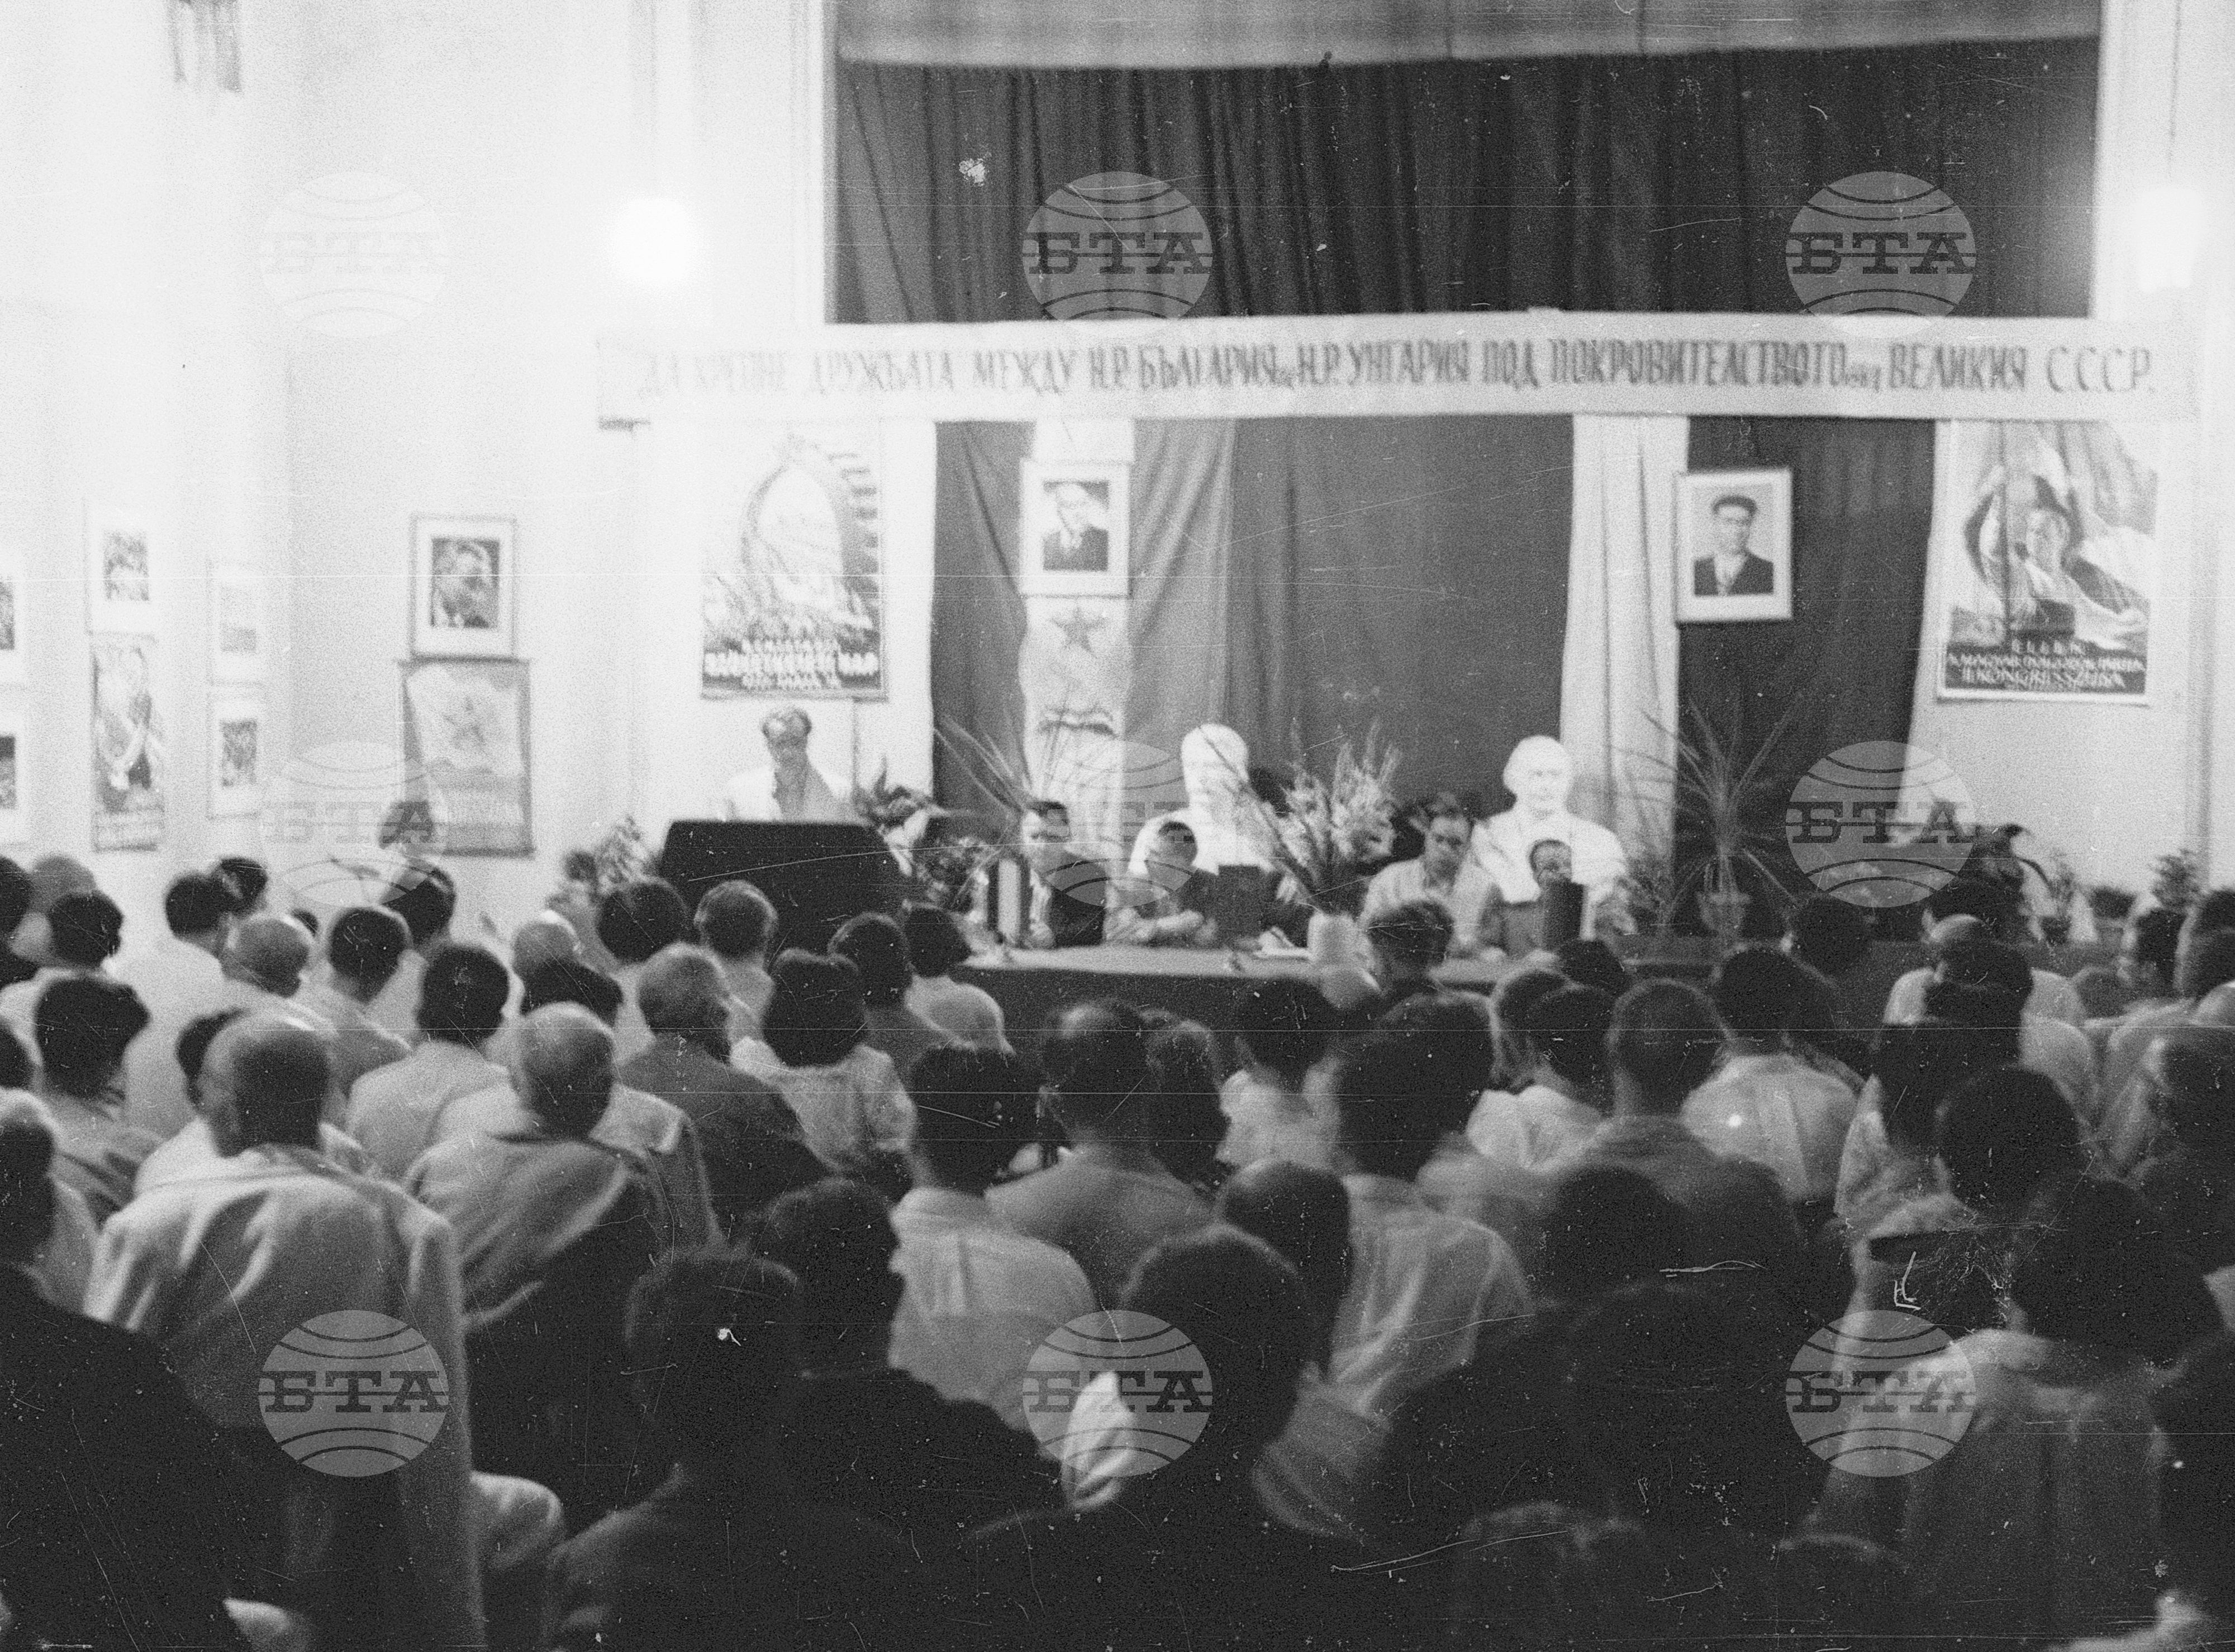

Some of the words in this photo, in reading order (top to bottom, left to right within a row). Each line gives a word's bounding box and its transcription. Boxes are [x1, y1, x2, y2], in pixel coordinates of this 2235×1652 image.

[806, 349, 955, 394] ДРУЖБАТА
[972, 347, 1077, 394] МЕЖДУ
[1137, 344, 1276, 389] БЪЛГАРИЯ
[1347, 340, 1470, 385] УНГАРИЯ
[1483, 340, 1539, 389] ПОД
[1547, 338, 1846, 387] ПОКРОВИТЕЛСТВОТО
[1889, 342, 2027, 391] ВЕЛИКИЯ
